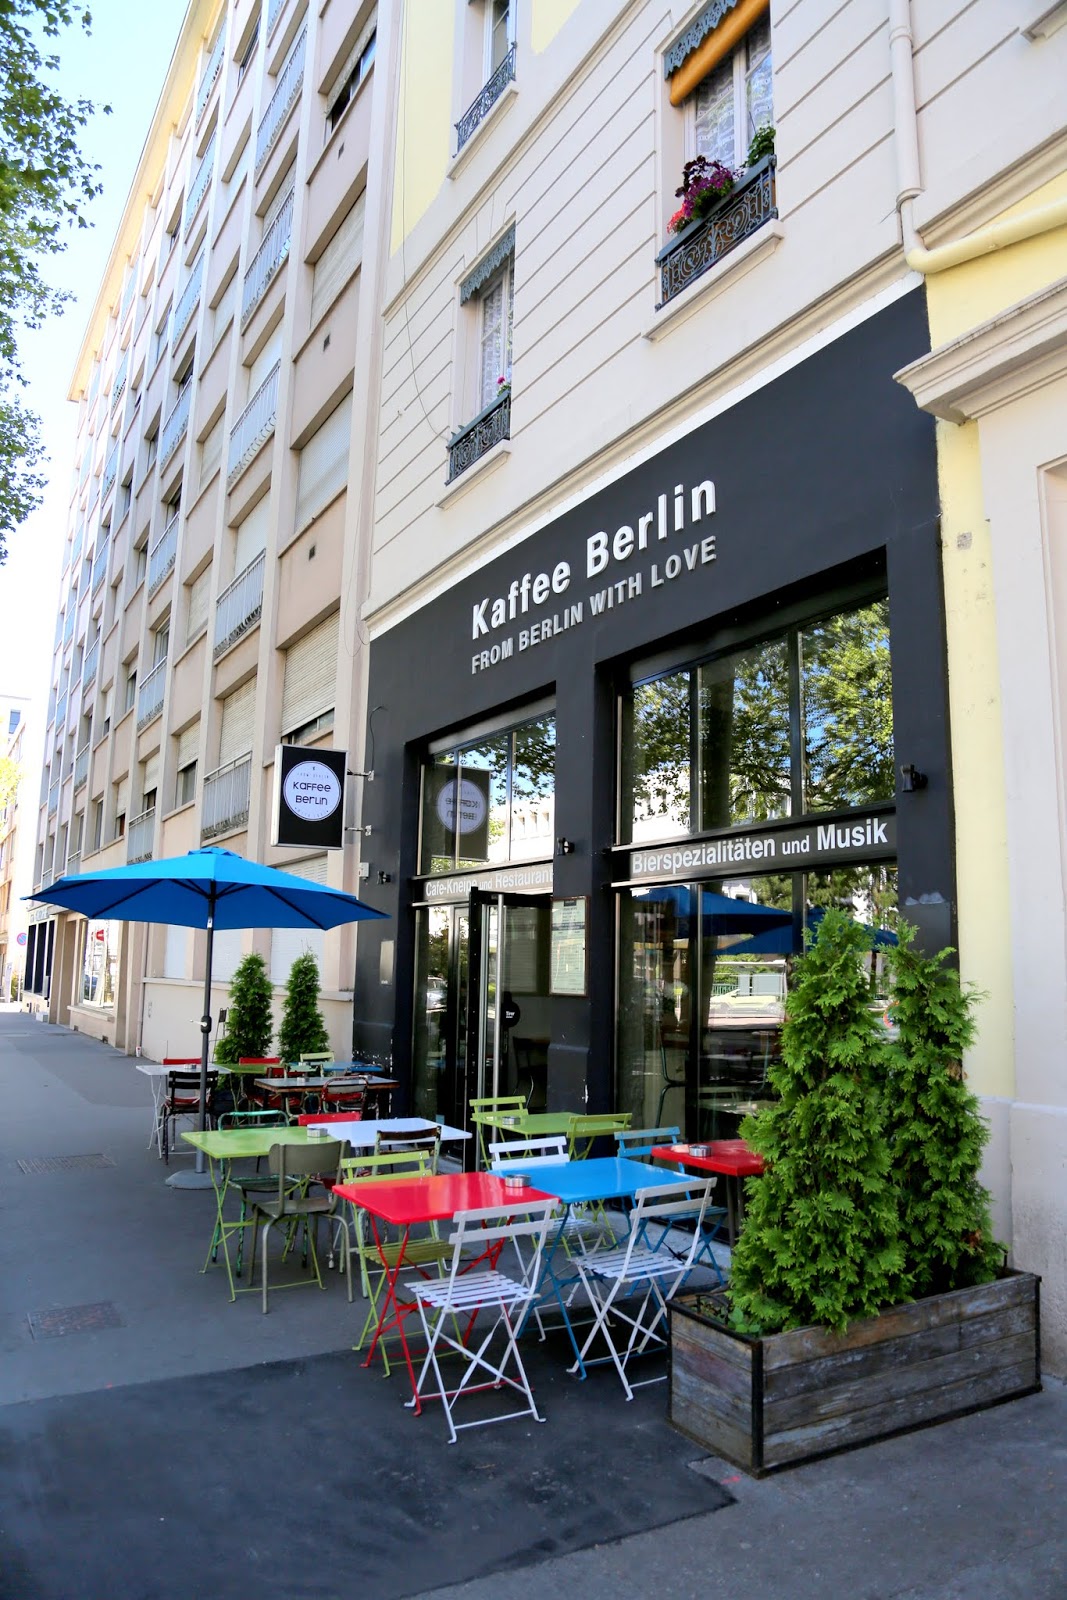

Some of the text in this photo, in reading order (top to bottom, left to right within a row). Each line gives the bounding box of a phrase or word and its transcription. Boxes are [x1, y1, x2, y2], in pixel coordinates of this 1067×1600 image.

[471, 535, 717, 675] FROM BERLIN WITH LOVE
[472, 480, 716, 640] Kaffee Berlin
[480, 879, 493, 890] und
[632, 817, 888, 874] Bierspezialitäten und Musik
